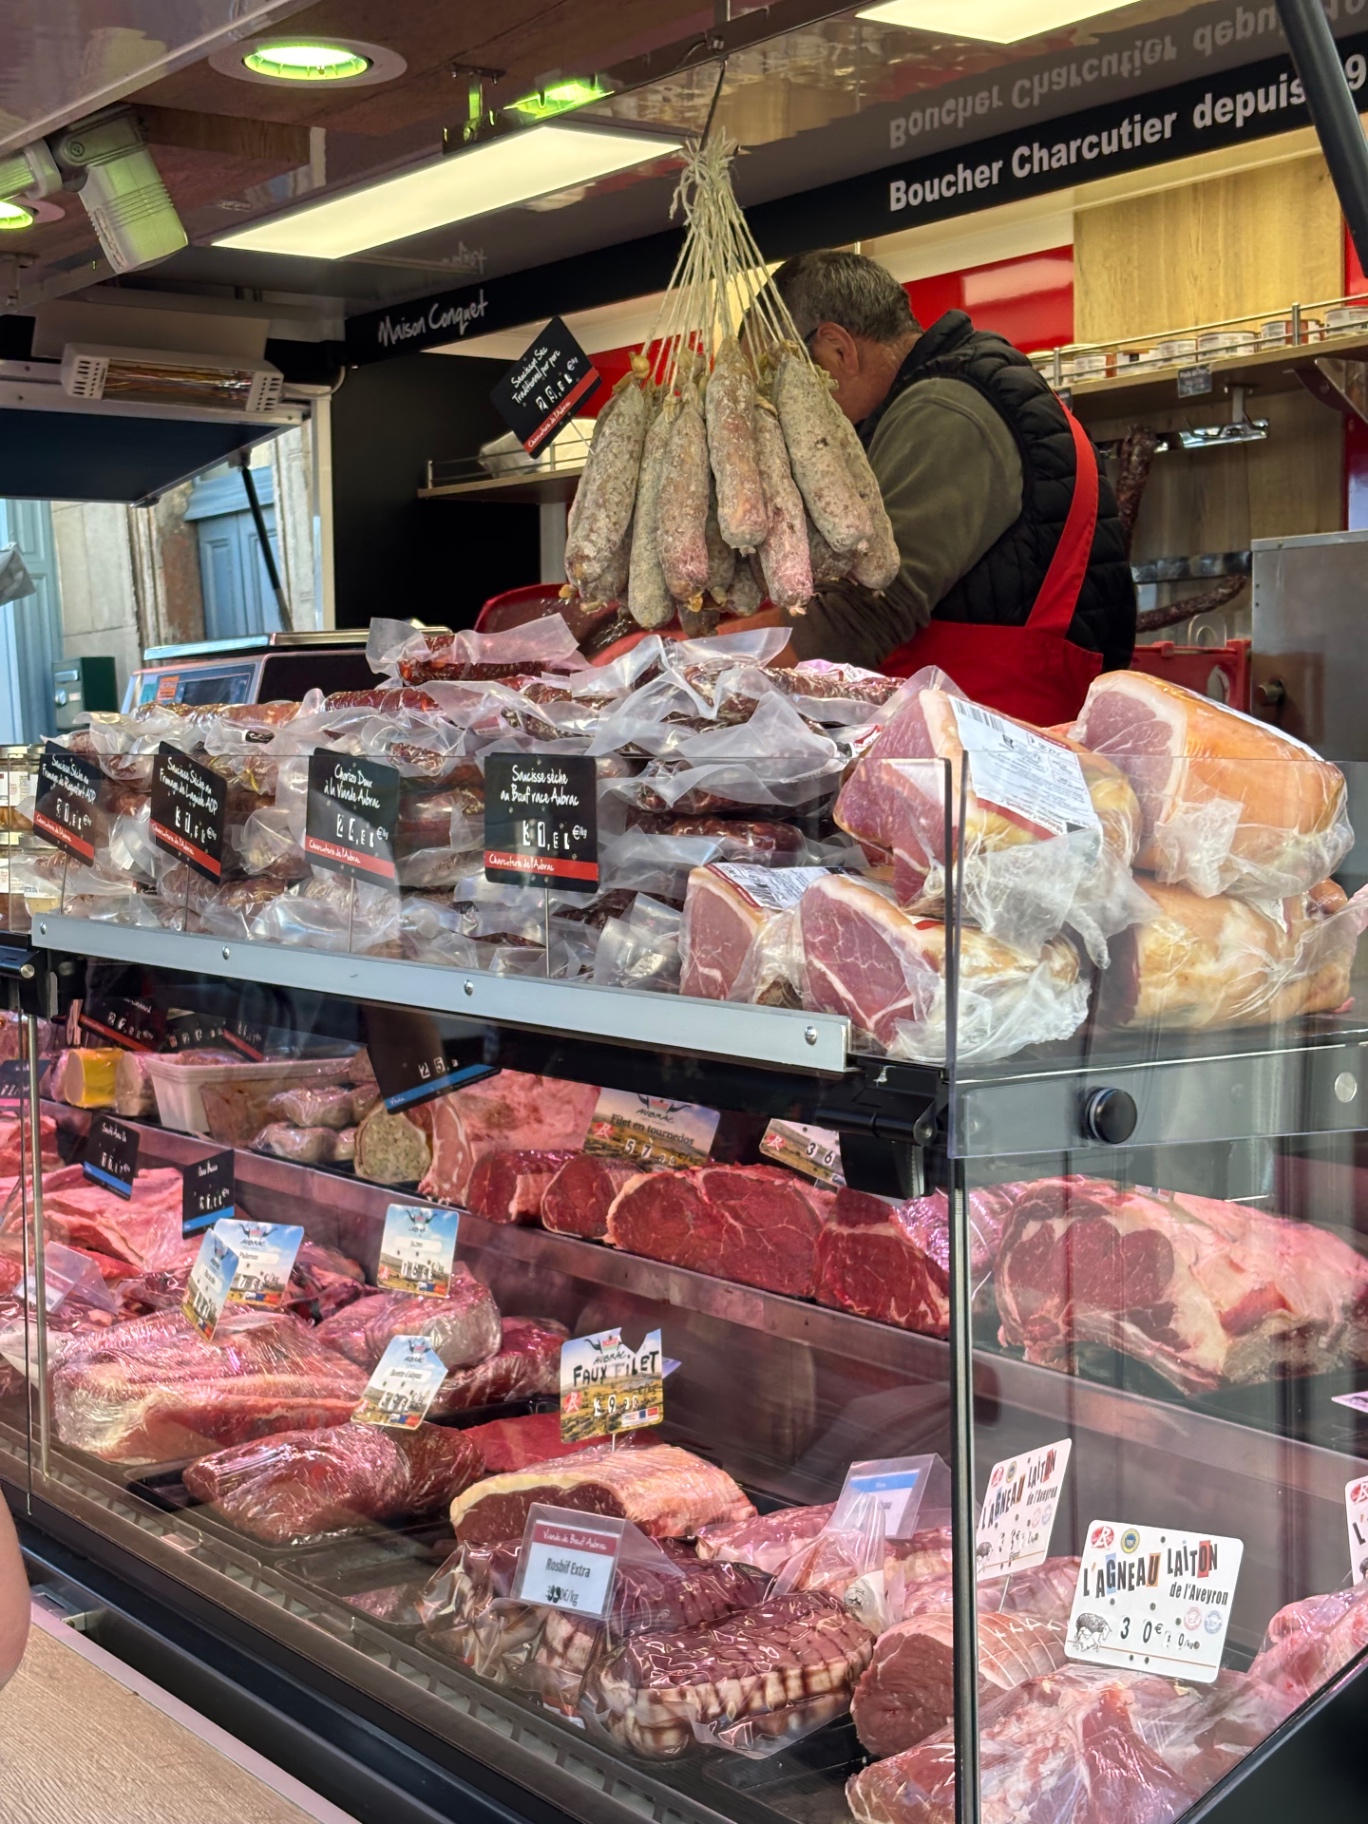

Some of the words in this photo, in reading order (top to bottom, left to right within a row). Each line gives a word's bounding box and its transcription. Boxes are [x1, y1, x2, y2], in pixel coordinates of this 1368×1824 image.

[889, 158, 1002, 212] Boucher
[1011, 108, 1178, 179] Charcutier
[1192, 73, 1306, 129] depuis
[378, 315, 426, 347] Maison
[428, 289, 488, 335] Conquet
[334, 764, 357, 784] Chorizo
[512, 764, 546, 783] Saucisse
[547, 768, 569, 785] sèche
[532, 792, 550, 805] race
[551, 786, 580, 806] Aubrac
[611, 1114, 631, 1129] Filet
[633, 1121, 645, 1132] en
[646, 1125, 695, 1146] tournedos
[573, 1364, 607, 1387] FAUX
[546, 1558, 570, 1574] Rosbif
[571, 1562, 591, 1578] Extra
[1083, 1556, 1160, 1598] L'AGNEAU
[1169, 1582, 1181, 1599] de
[1183, 1583, 1229, 1605] l'Aveyron
